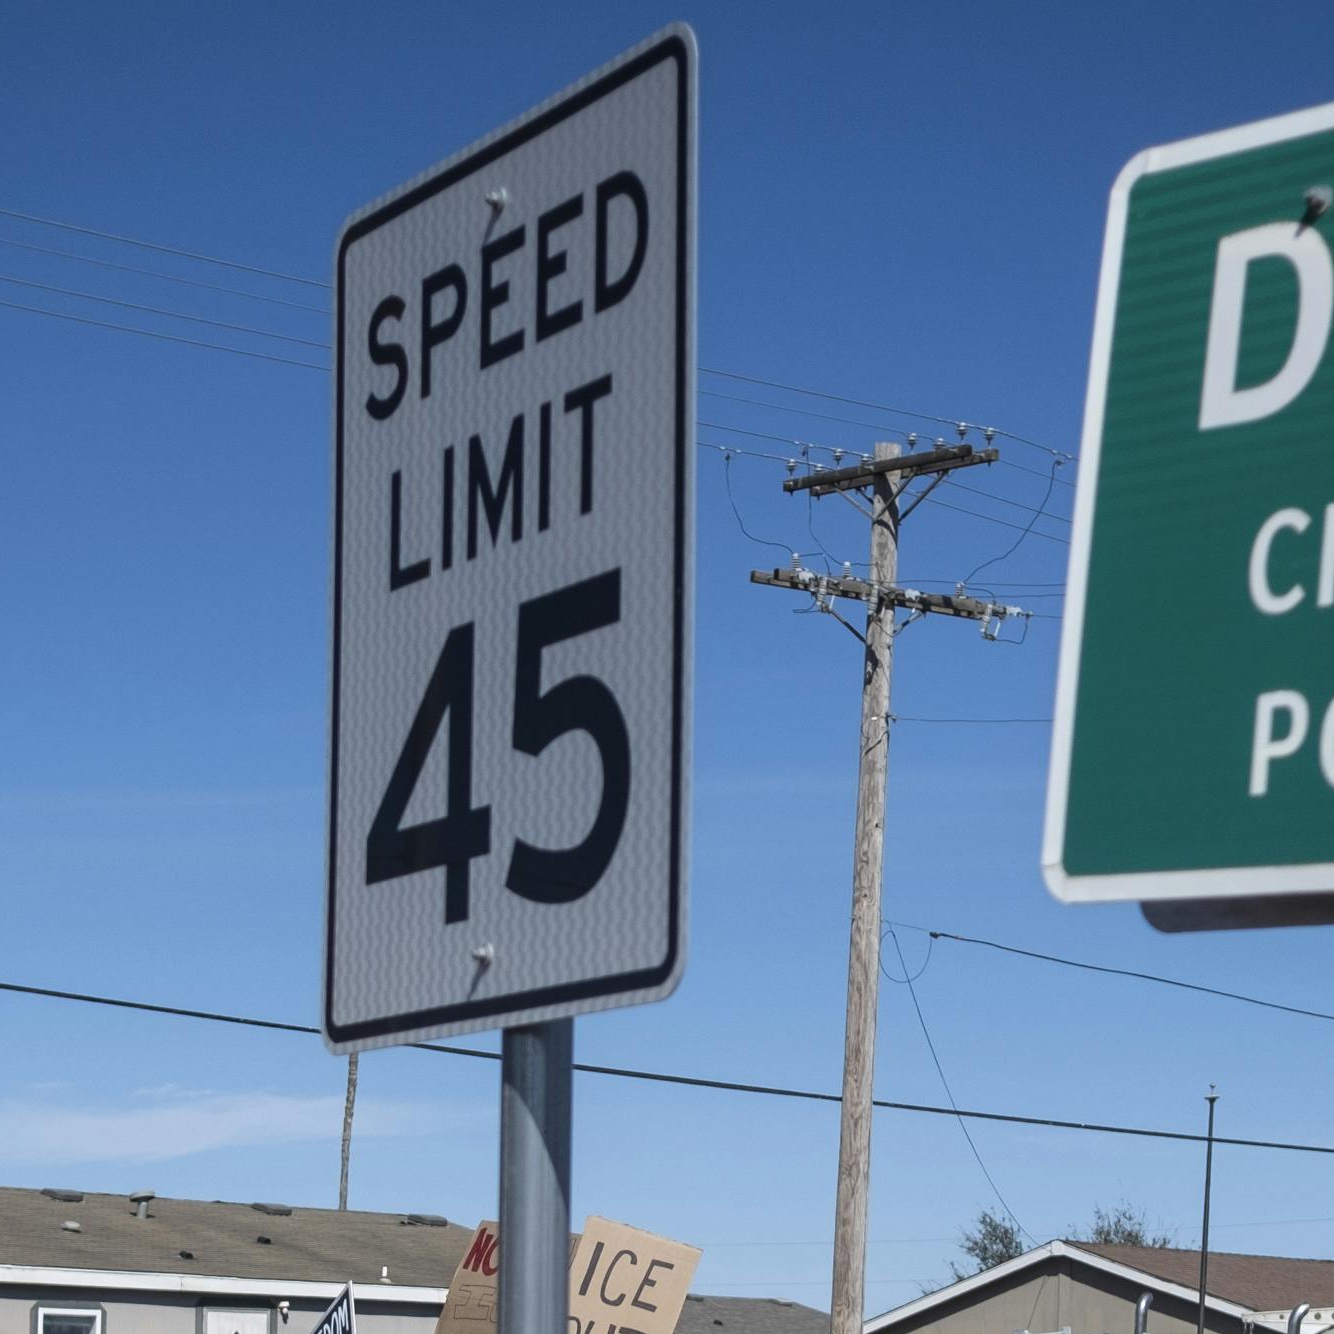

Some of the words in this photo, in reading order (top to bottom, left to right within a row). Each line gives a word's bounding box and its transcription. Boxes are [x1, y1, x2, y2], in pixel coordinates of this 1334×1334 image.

[365, 170, 649, 421] SPEED
[389, 374, 613, 593] LIMIT
[365, 566, 633, 925] 45
[578, 1241, 675, 1313] ICE
